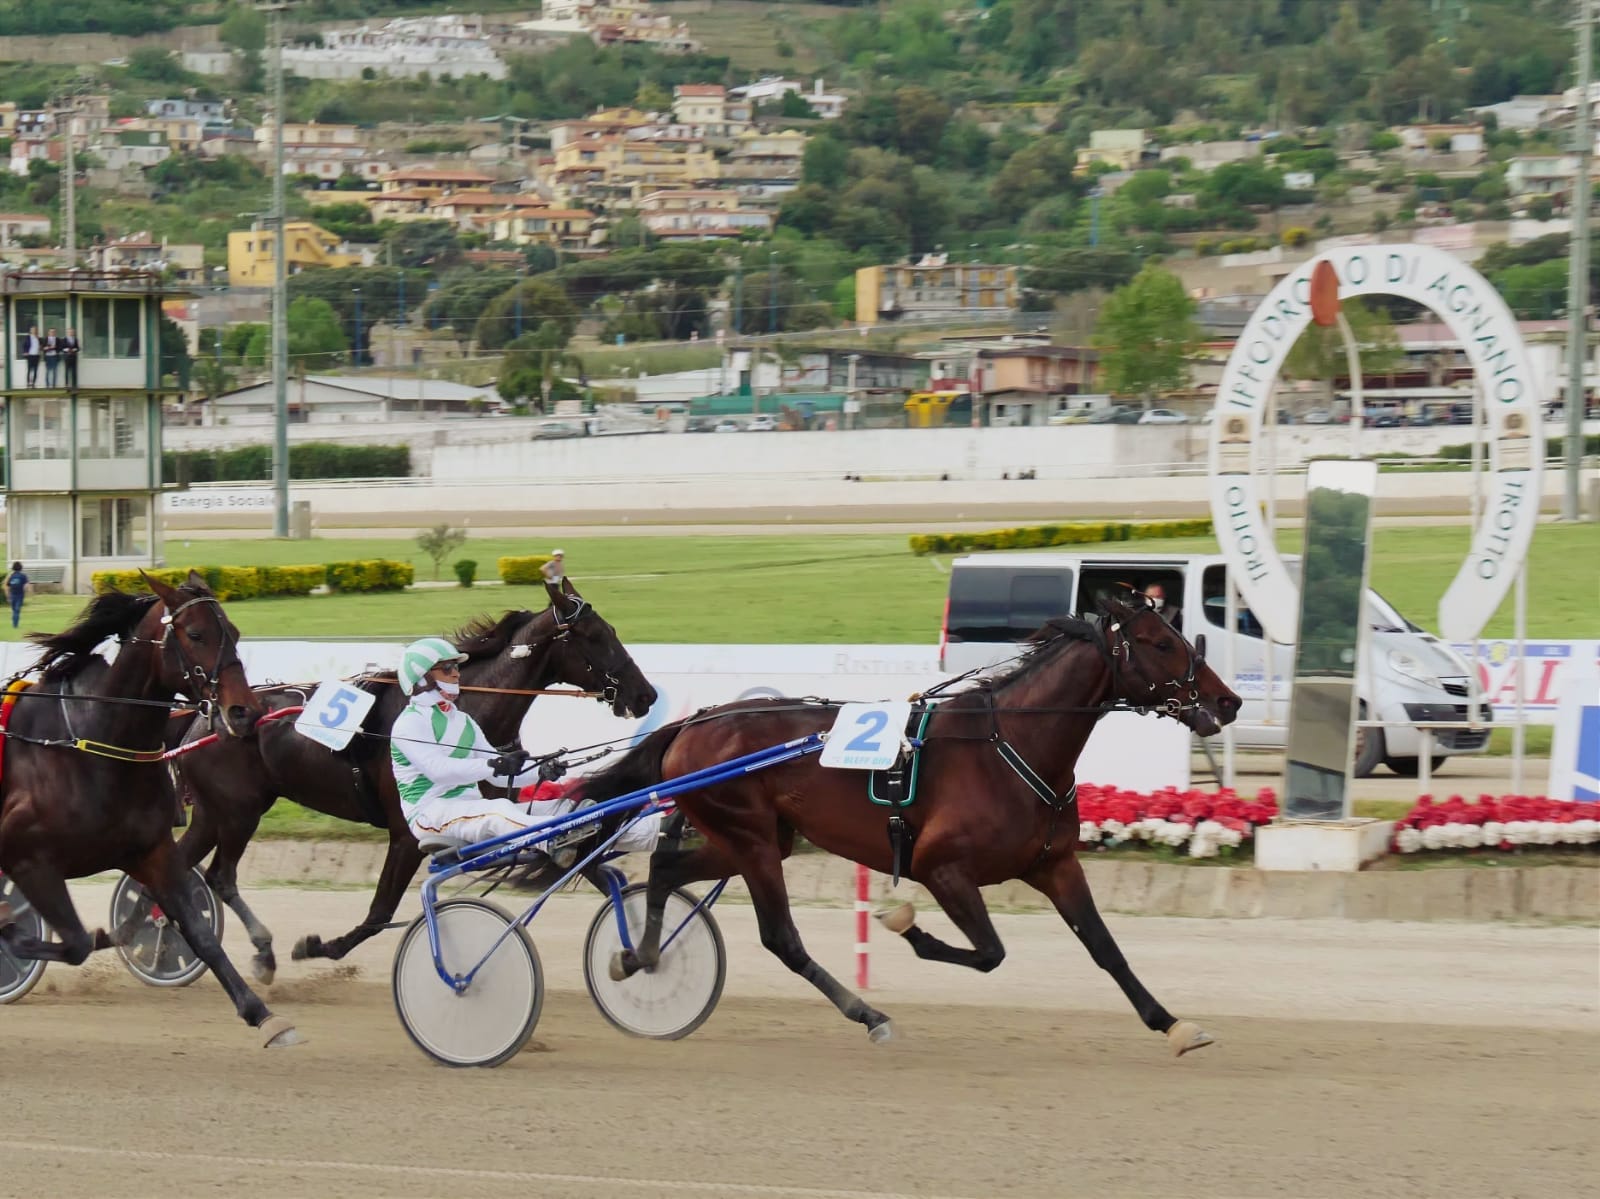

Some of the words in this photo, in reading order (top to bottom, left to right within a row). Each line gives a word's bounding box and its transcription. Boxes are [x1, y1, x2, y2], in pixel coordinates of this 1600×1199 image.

[1227, 254, 1371, 409] IPPODROO
[1384, 252, 1421, 287] DI
[1426, 271, 1525, 405] AGNANO
[170, 495, 224, 509] Energia
[319, 687, 359, 729] 5
[843, 709, 890, 752] 2
